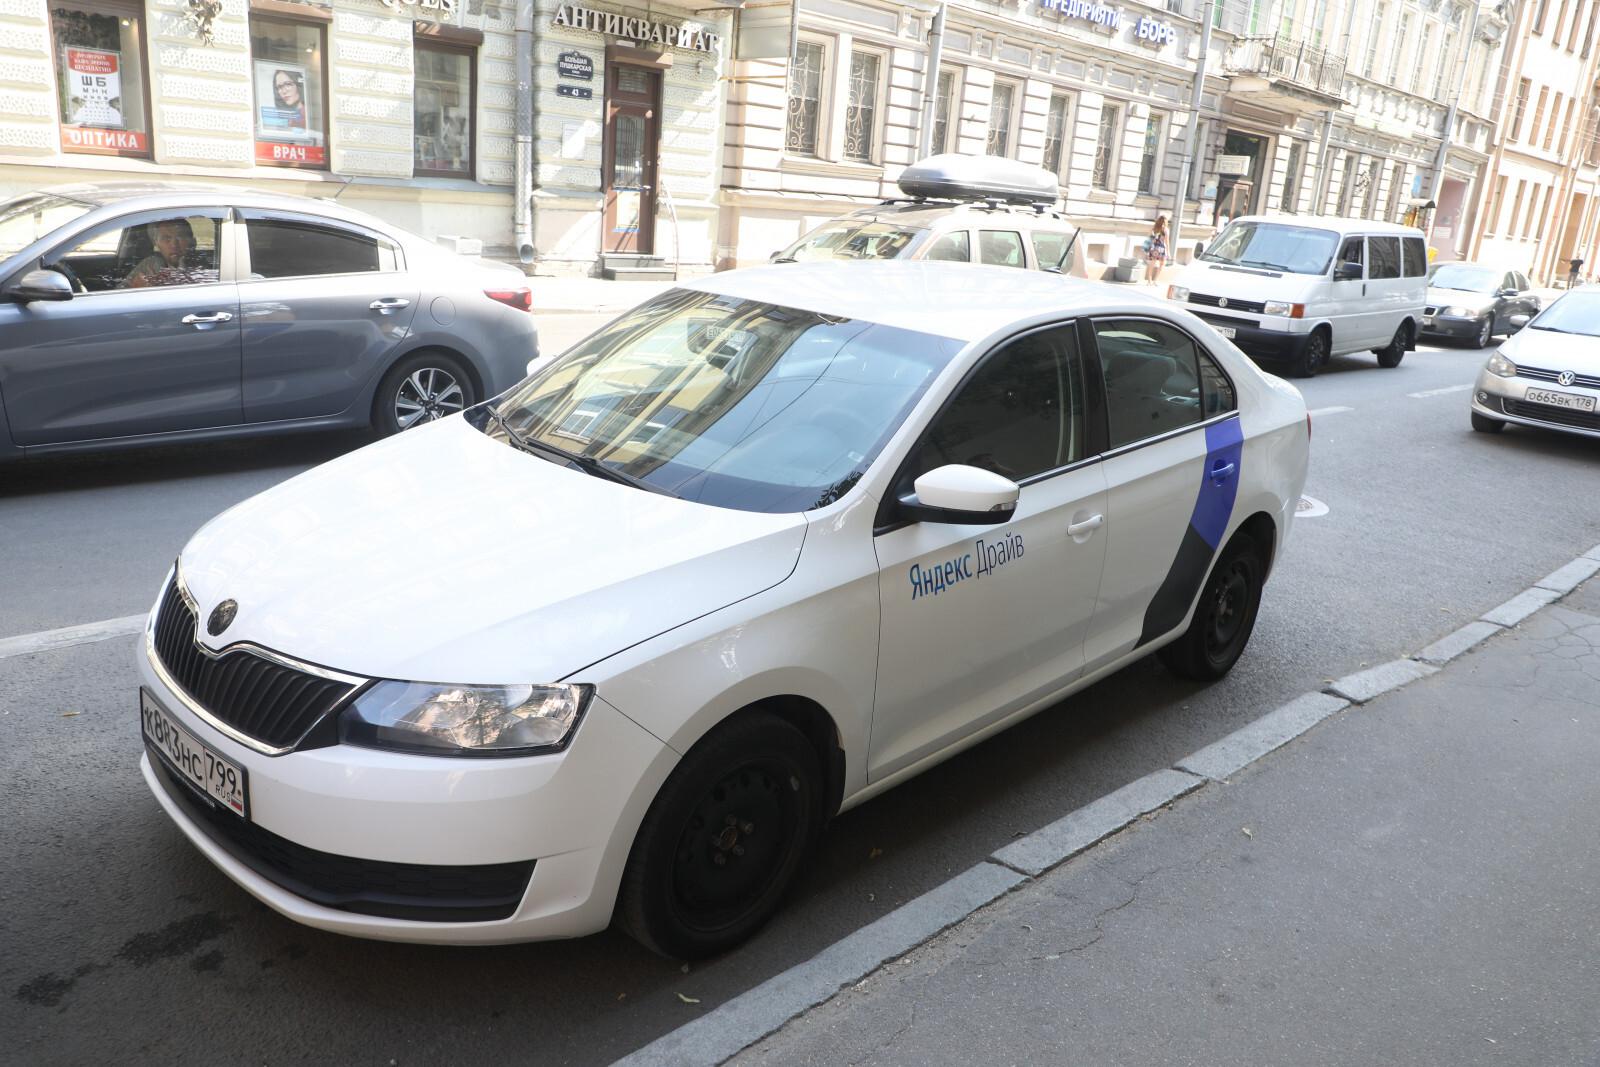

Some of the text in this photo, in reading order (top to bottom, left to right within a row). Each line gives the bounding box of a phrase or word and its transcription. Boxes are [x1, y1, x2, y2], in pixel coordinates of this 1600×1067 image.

[553, 4, 724, 52] АНТИКВАРИАТ
[560, 61, 592, 72] ПУШКАРСКАЯ
[565, 56, 588, 64] БОЛЬШАЯ
[572, 88, 579, 96] 43
[70, 130, 138, 148] ОПТИКА
[273, 146, 306, 160] ВРАЧ
[909, 532, 1025, 600] Яндекс Драйв
[205, 752, 236, 796] 799
